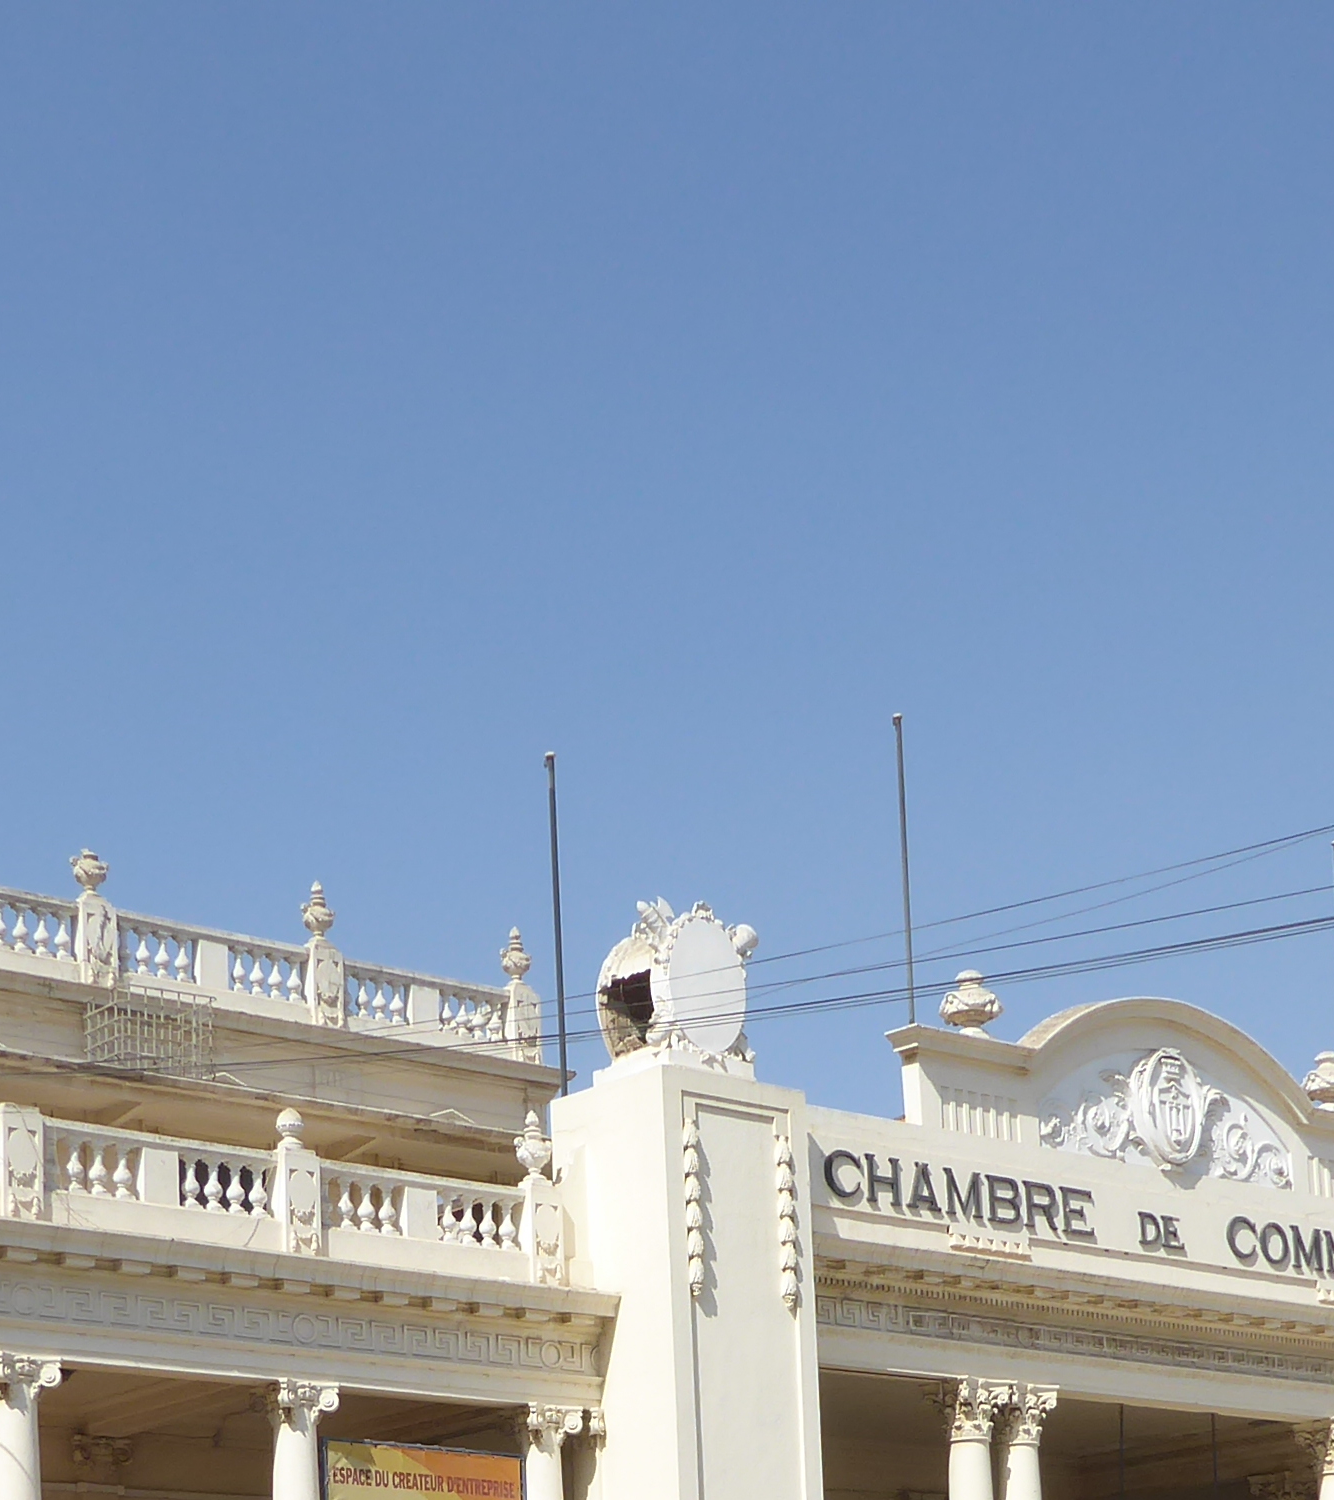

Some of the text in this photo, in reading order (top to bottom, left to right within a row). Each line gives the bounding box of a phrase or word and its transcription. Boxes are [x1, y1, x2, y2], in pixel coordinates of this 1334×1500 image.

[823, 1148, 1096, 1238] CHAMBRE
[1138, 1211, 1187, 1251] DE
[332, 1466, 516, 1499] ESPACE DU CREATEUR D'ENTREPRISE
